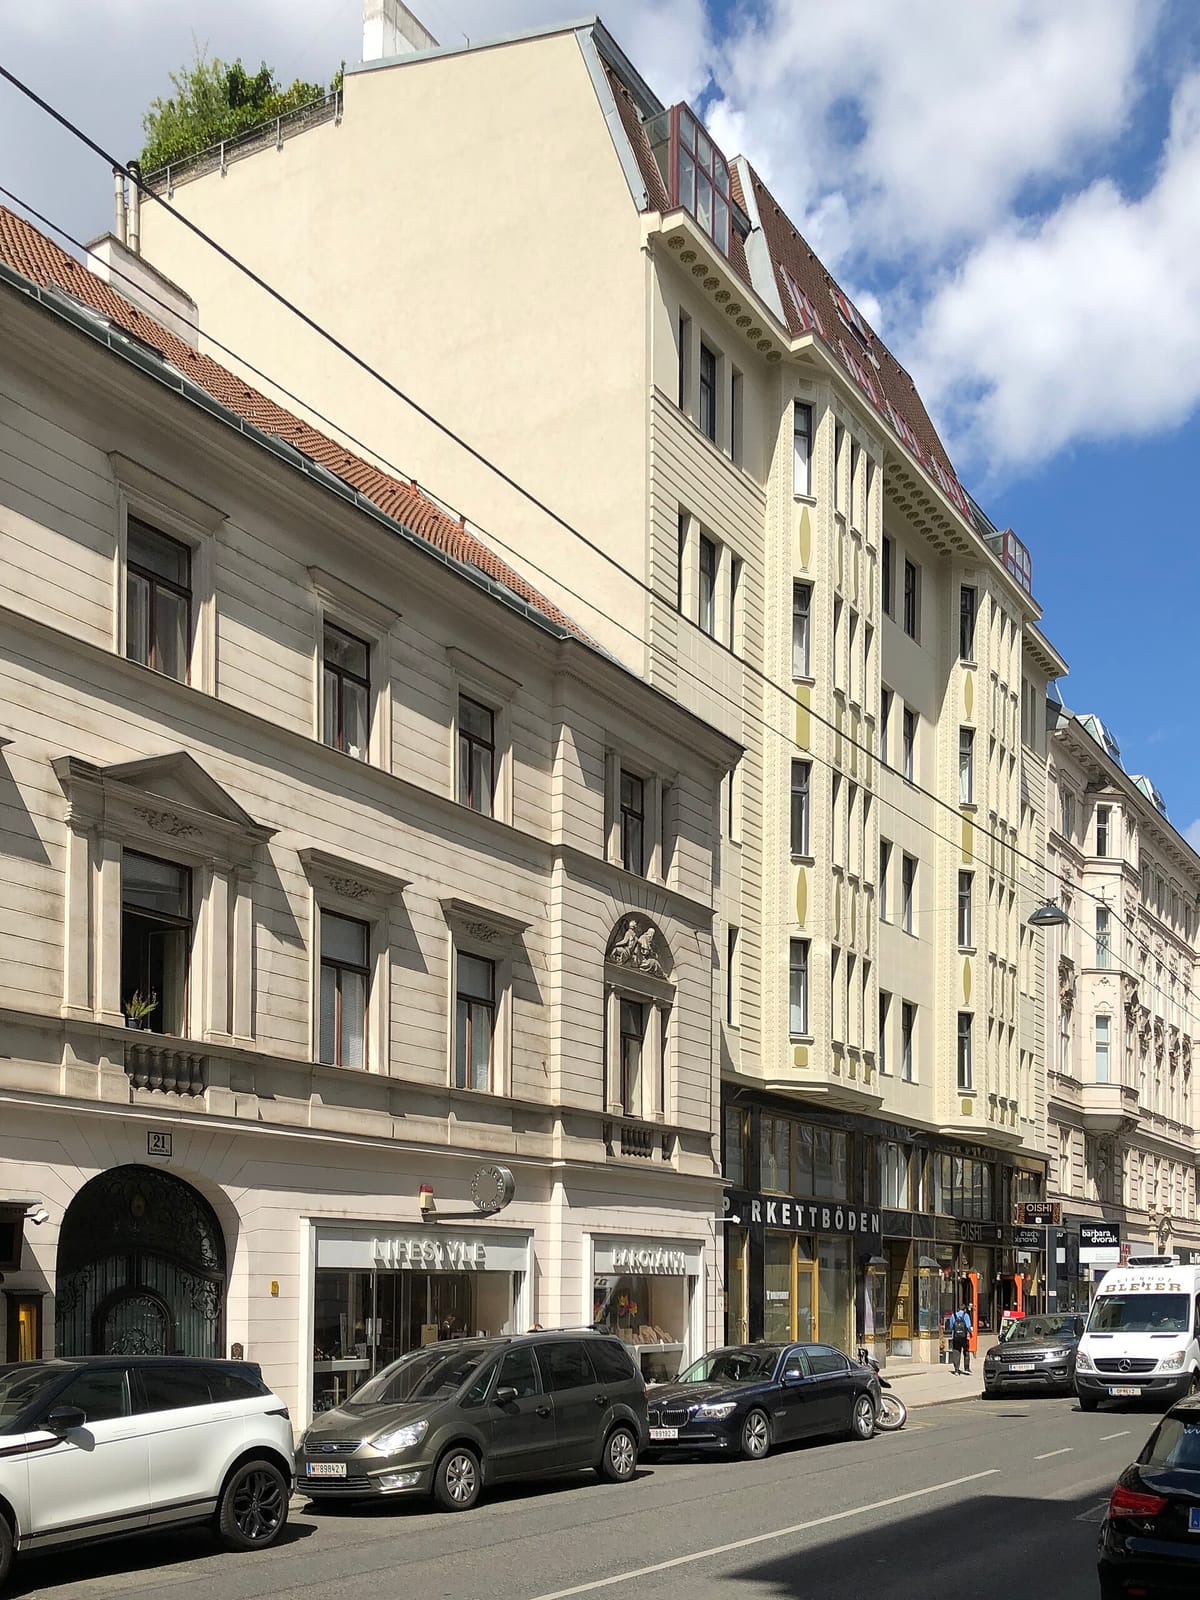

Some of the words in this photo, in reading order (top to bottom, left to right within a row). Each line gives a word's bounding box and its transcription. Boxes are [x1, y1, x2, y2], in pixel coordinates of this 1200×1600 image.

[153, 1135, 166, 1149] 21
[1026, 1203, 1052, 1213] OISHI
[1081, 1229, 1111, 1238] barbara
[1091, 1235, 1118, 1243] dvorak
[373, 1238, 486, 1261] LIFESTYLE
[1104, 1282, 1181, 1293] BLEIER
